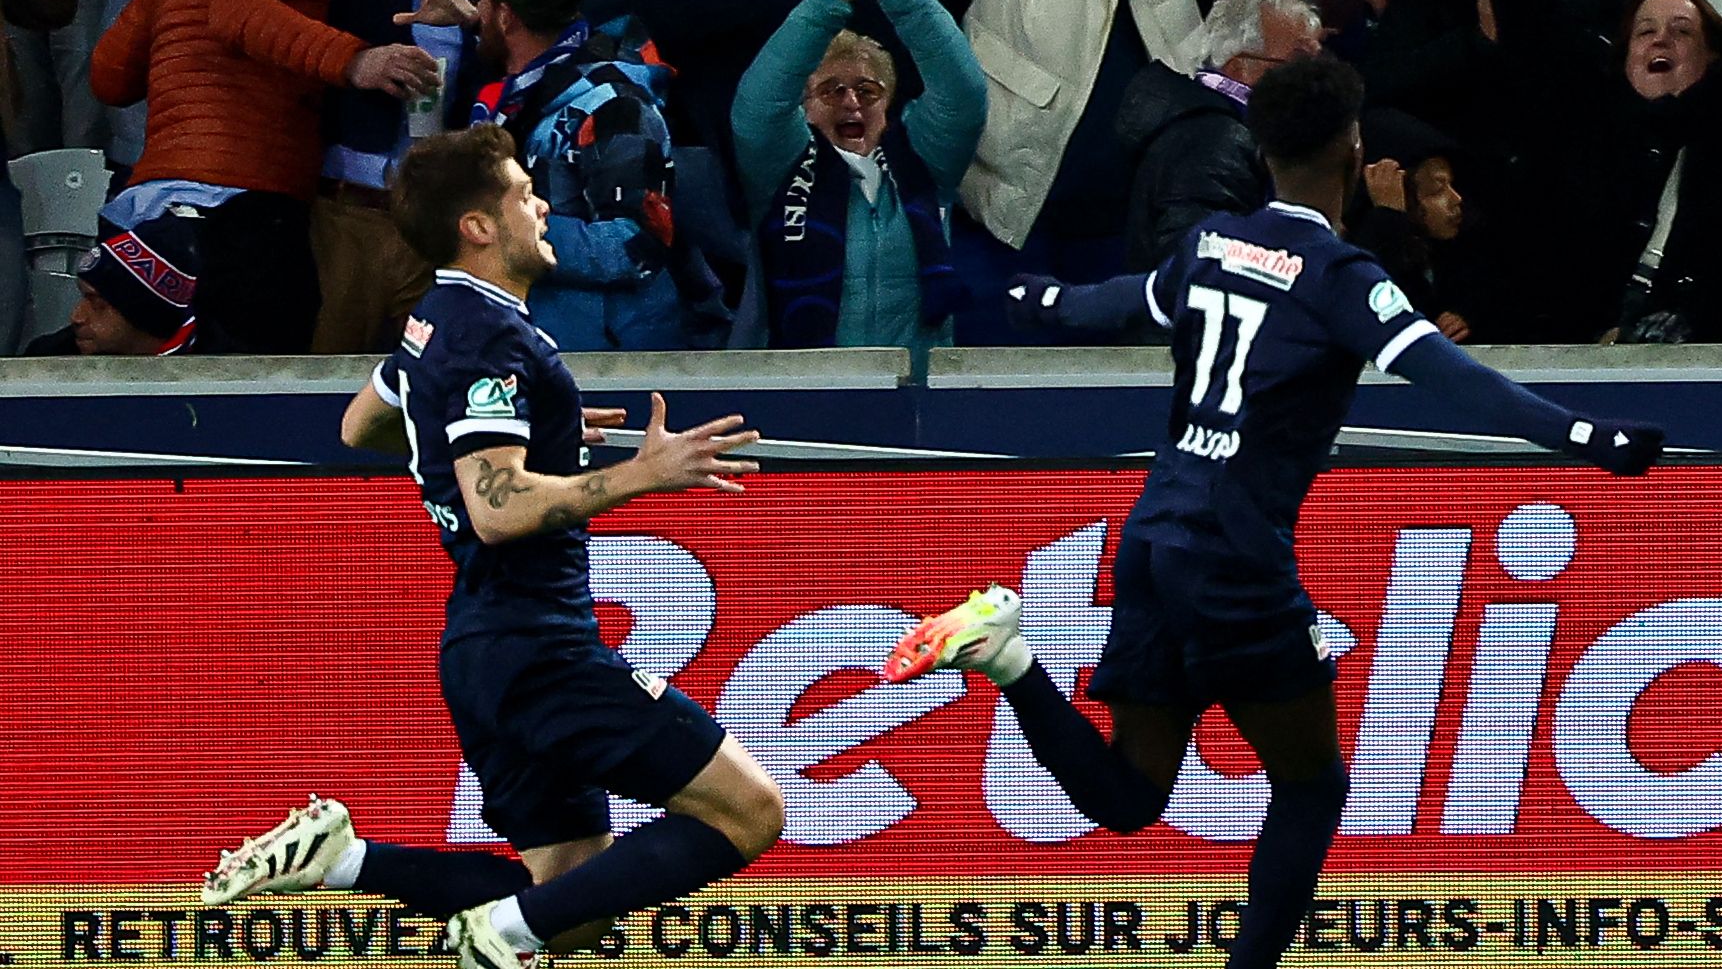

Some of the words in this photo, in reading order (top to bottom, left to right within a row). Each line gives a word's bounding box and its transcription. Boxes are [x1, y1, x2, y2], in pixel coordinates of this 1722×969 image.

[111, 238, 184, 296] PAR
[63, 908, 457, 960] RETROUVE
[653, 903, 985, 957] CONSEILS
[1012, 900, 1142, 954] SUR
